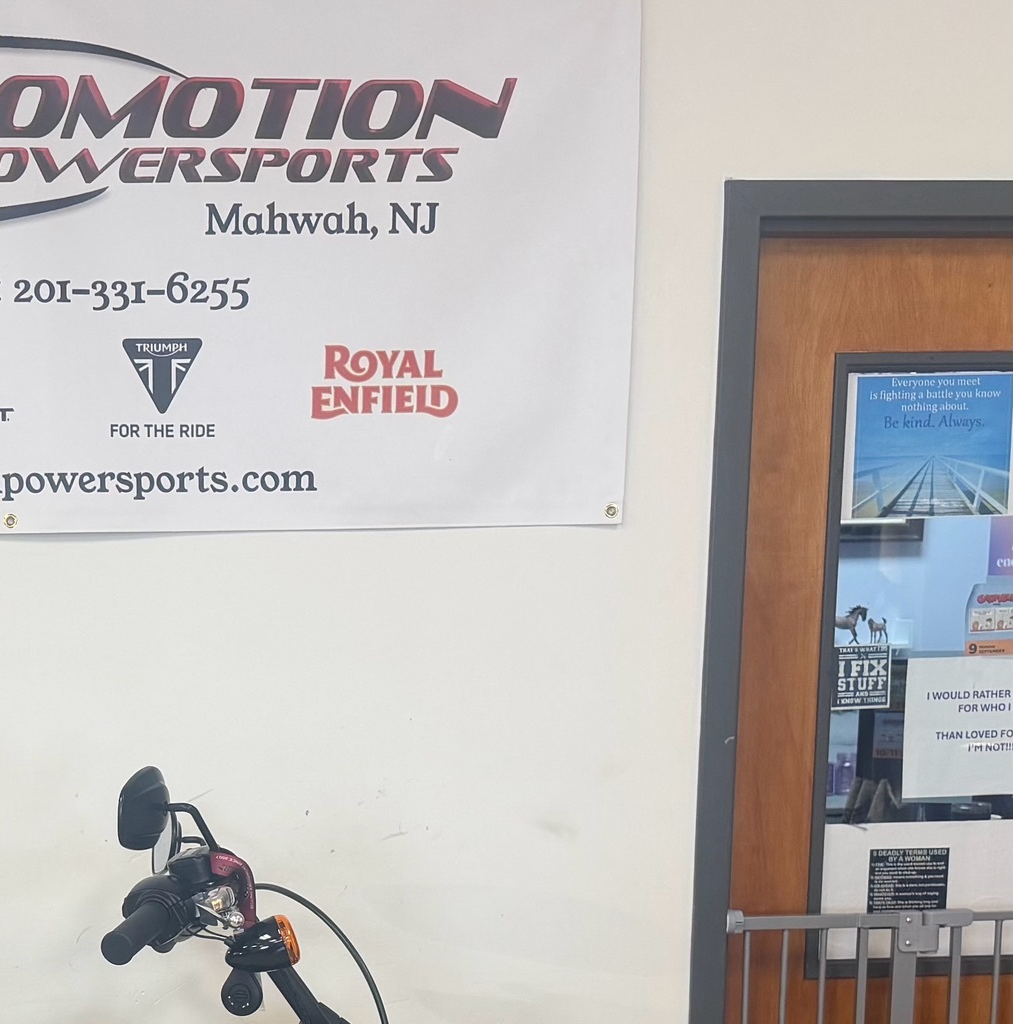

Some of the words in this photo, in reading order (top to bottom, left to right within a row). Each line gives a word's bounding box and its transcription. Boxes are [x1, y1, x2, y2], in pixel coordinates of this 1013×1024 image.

[205, 201, 379, 240] Mahwah,
[388, 202, 440, 235] NJ
[13, 271, 251, 311] 201-331-6255
[136, 343, 187, 354] TRIUMPH
[324, 344, 443, 382] ROYAL
[891, 378, 936, 389] Everyone
[937, 379, 955, 388] you
[957, 377, 981, 386] meet
[869, 391, 878, 400] is
[880, 390, 916, 401] fighting
[926, 389, 953, 399] battle
[955, 391, 973, 400] you
[975, 388, 1001, 398] know
[311, 384, 459, 420] ENFIELD
[901, 402, 938, 413] nothing
[939, 402, 969, 411] about.
[884, 415, 899, 429] Be
[903, 413, 935, 428] kind.
[938, 413, 985, 431] Always.
[110, 423, 141, 438] FOR
[143, 423, 175, 438] THE
[179, 423, 216, 438] RIDE
[969, 643, 978, 654] 9
[838, 660, 846, 677] I
[850, 659, 888, 677] FIX
[837, 676, 887, 691] STUFF
[926, 692, 930, 700] I
[932, 691, 971, 700] WOULD
[972, 689, 1012, 699] RATHER
[958, 704, 979, 713] FOR
[980, 703, 1006, 712] WHO
[1008, 702, 1012, 711] I
[935, 731, 963, 740] THAN
[965, 730, 998, 739] LOVED
[967, 743, 983, 752] I'M
